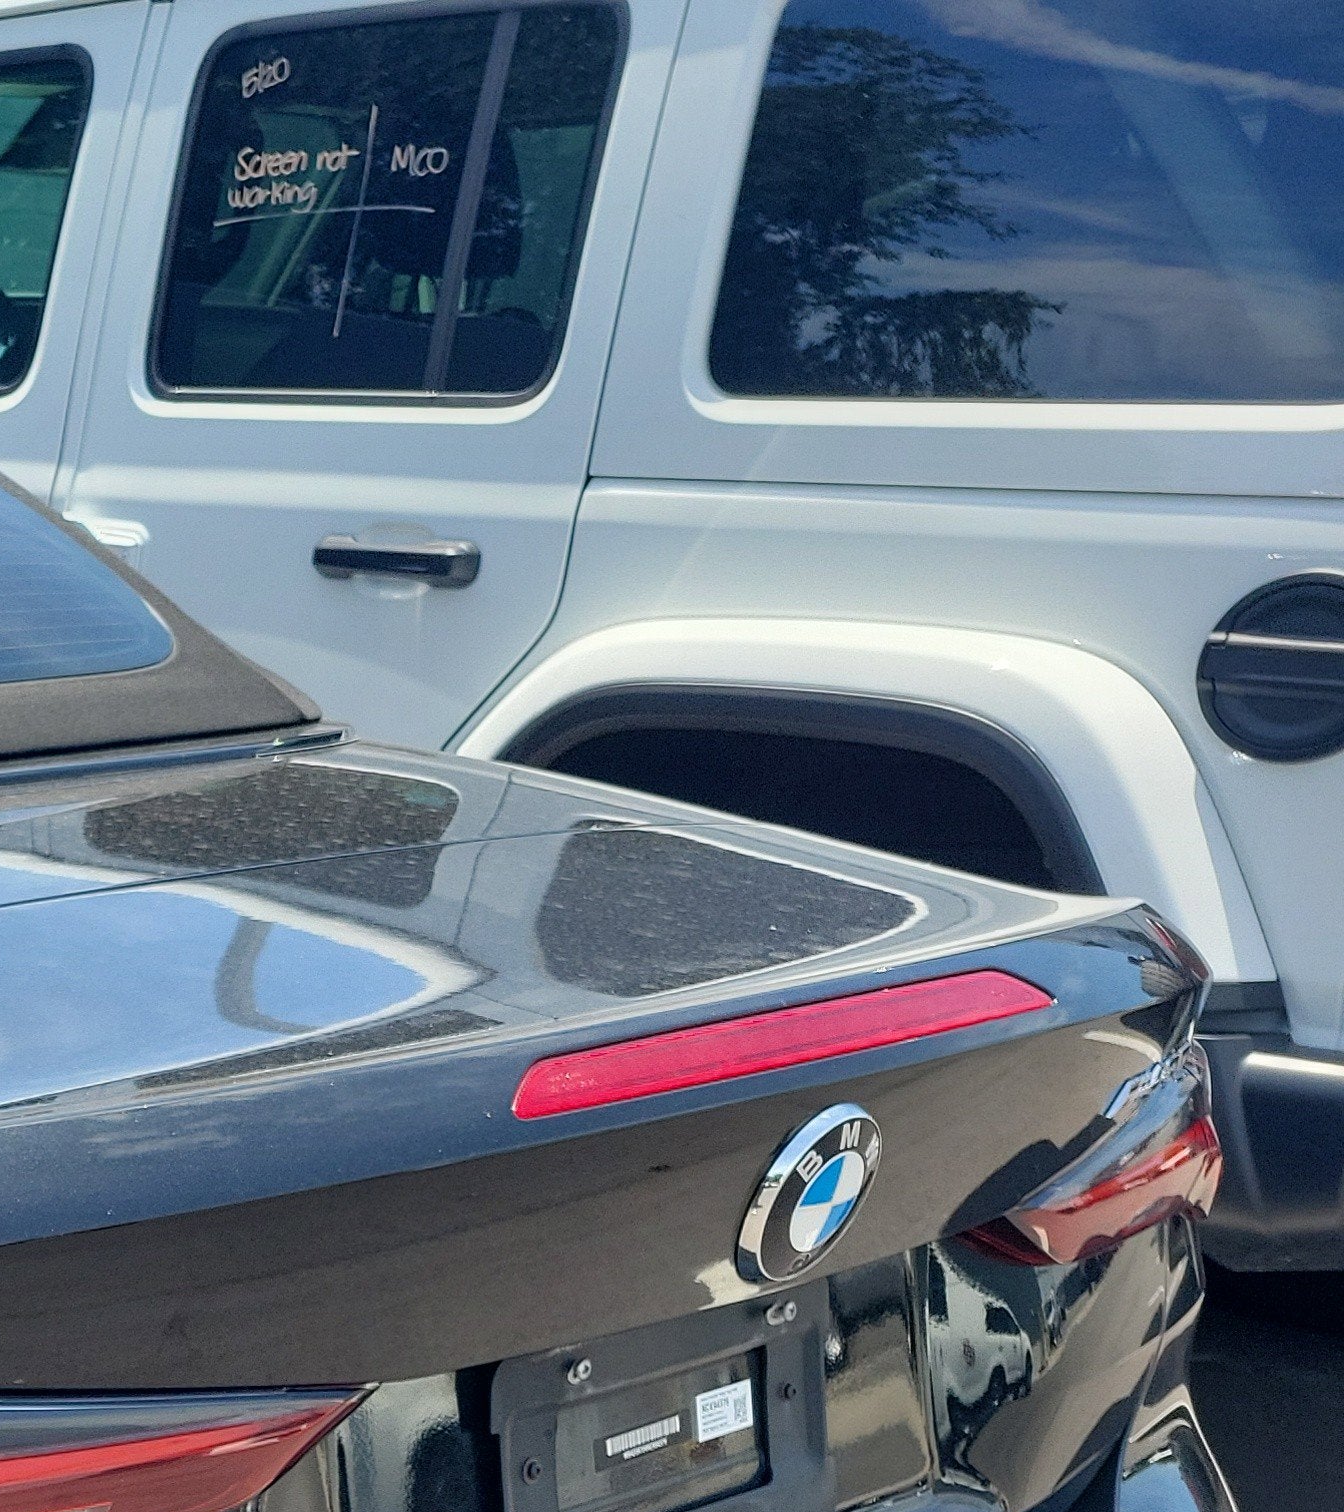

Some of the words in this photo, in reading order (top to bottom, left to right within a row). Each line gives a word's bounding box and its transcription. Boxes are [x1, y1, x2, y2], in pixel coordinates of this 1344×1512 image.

[234, 146, 309, 181] Screen
[315, 141, 361, 172] not
[390, 143, 450, 177] MCO
[227, 180, 318, 214] working
[796, 1120, 880, 1183] BMW
